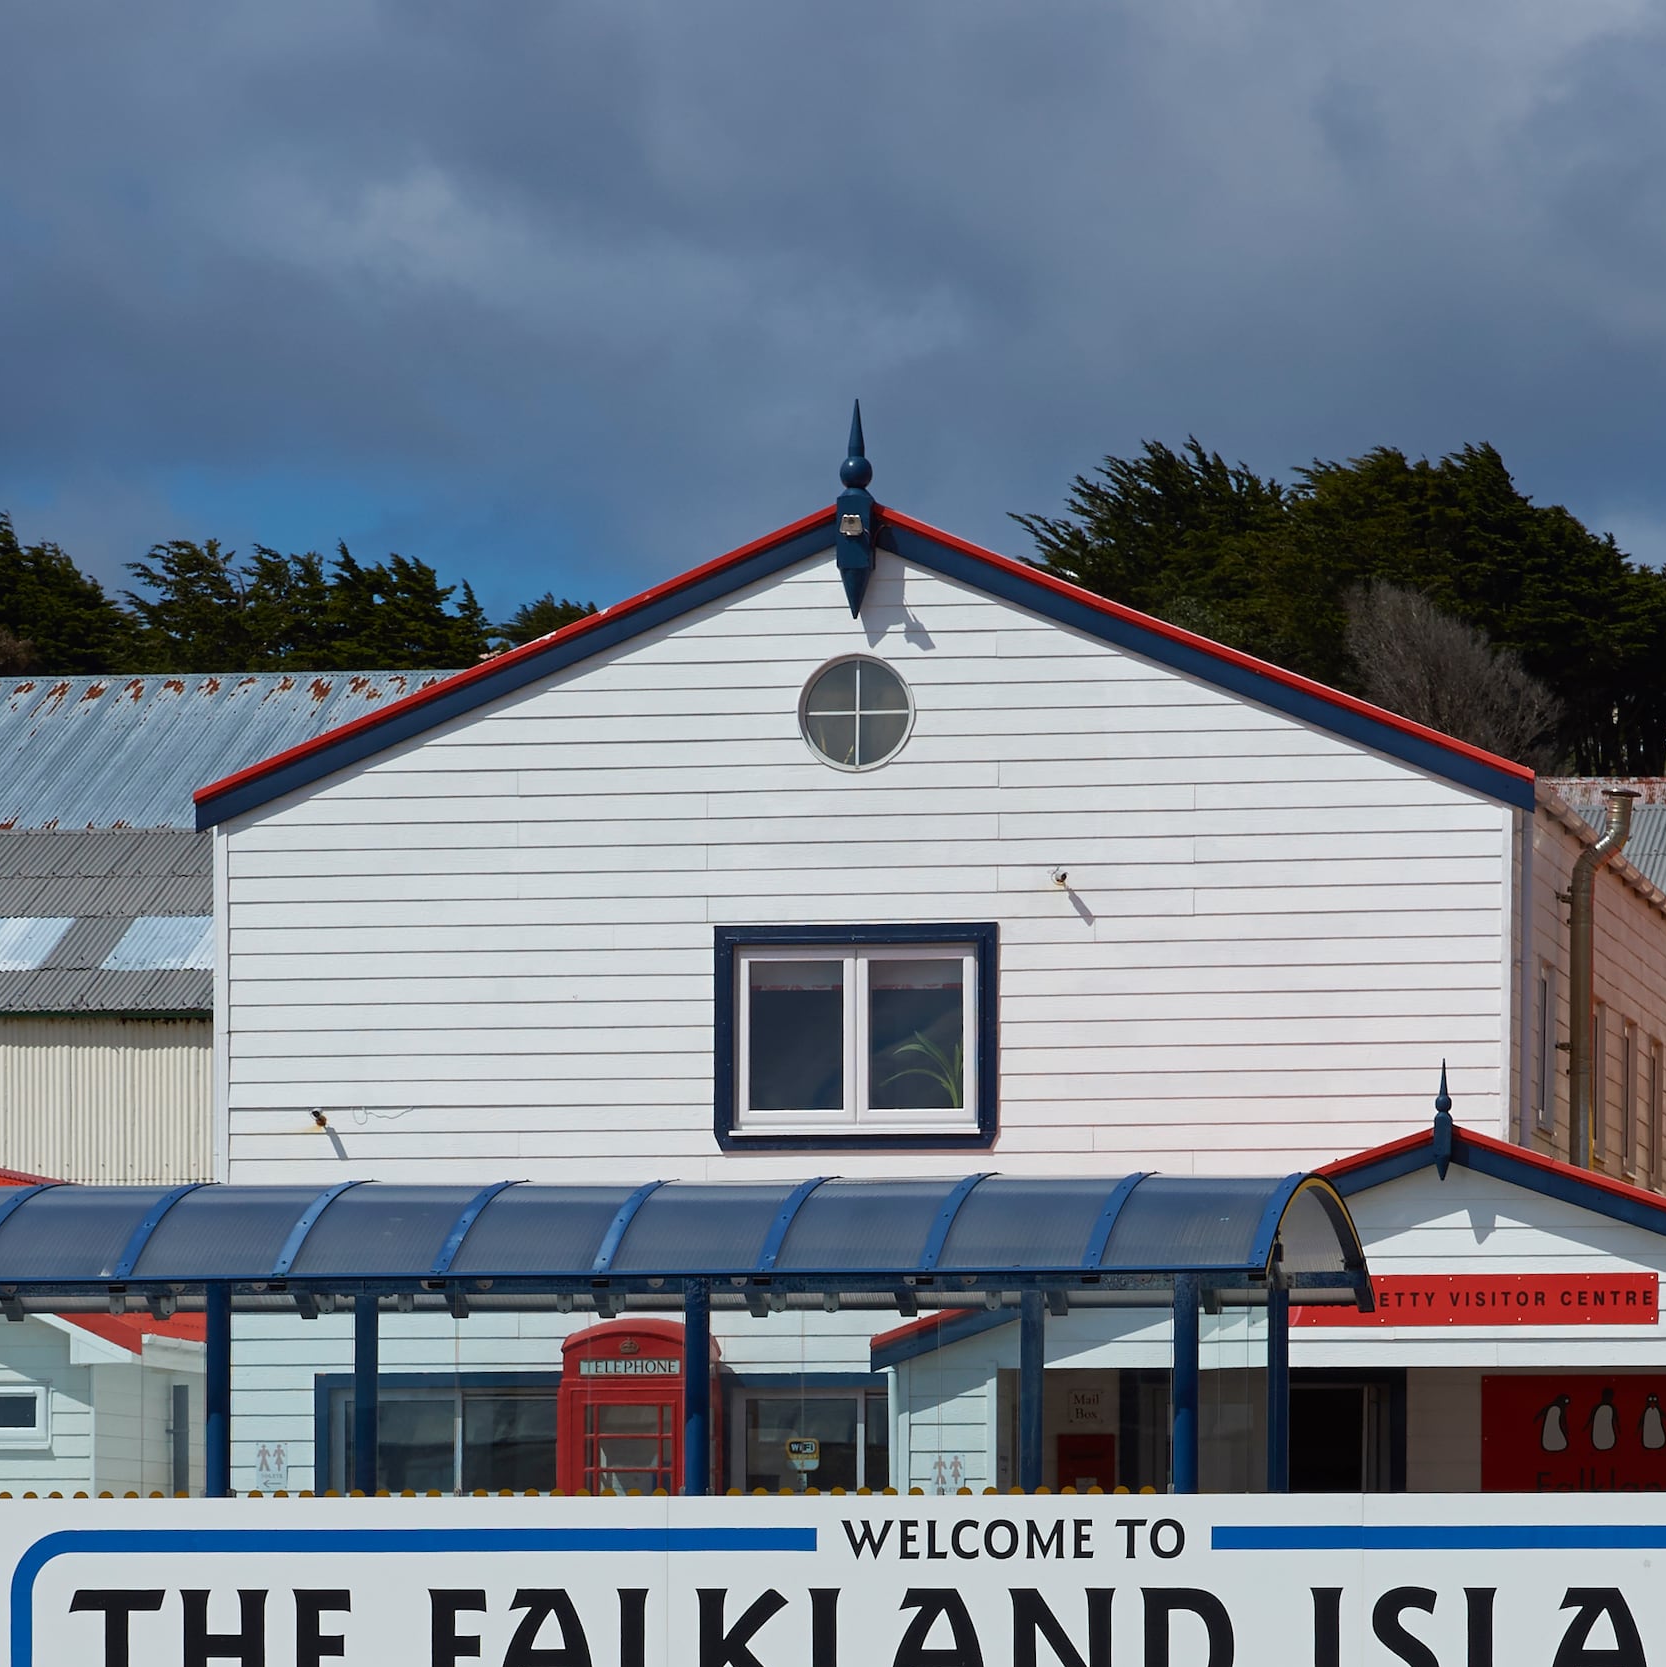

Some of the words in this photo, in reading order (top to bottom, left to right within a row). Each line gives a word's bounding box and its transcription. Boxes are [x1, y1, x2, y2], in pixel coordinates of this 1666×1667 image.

[1379, 1291, 1436, 1307] ETTY
[1449, 1291, 1547, 1307] VISITOR
[1559, 1290, 1654, 1306] CENTRE
[581, 1359, 677, 1374] TELEPHONE
[1073, 1393, 1100, 1405] Mail
[1075, 1407, 1098, 1419] Box
[842, 1519, 1094, 1560] WELCOME
[1115, 1518, 1186, 1560] TO
